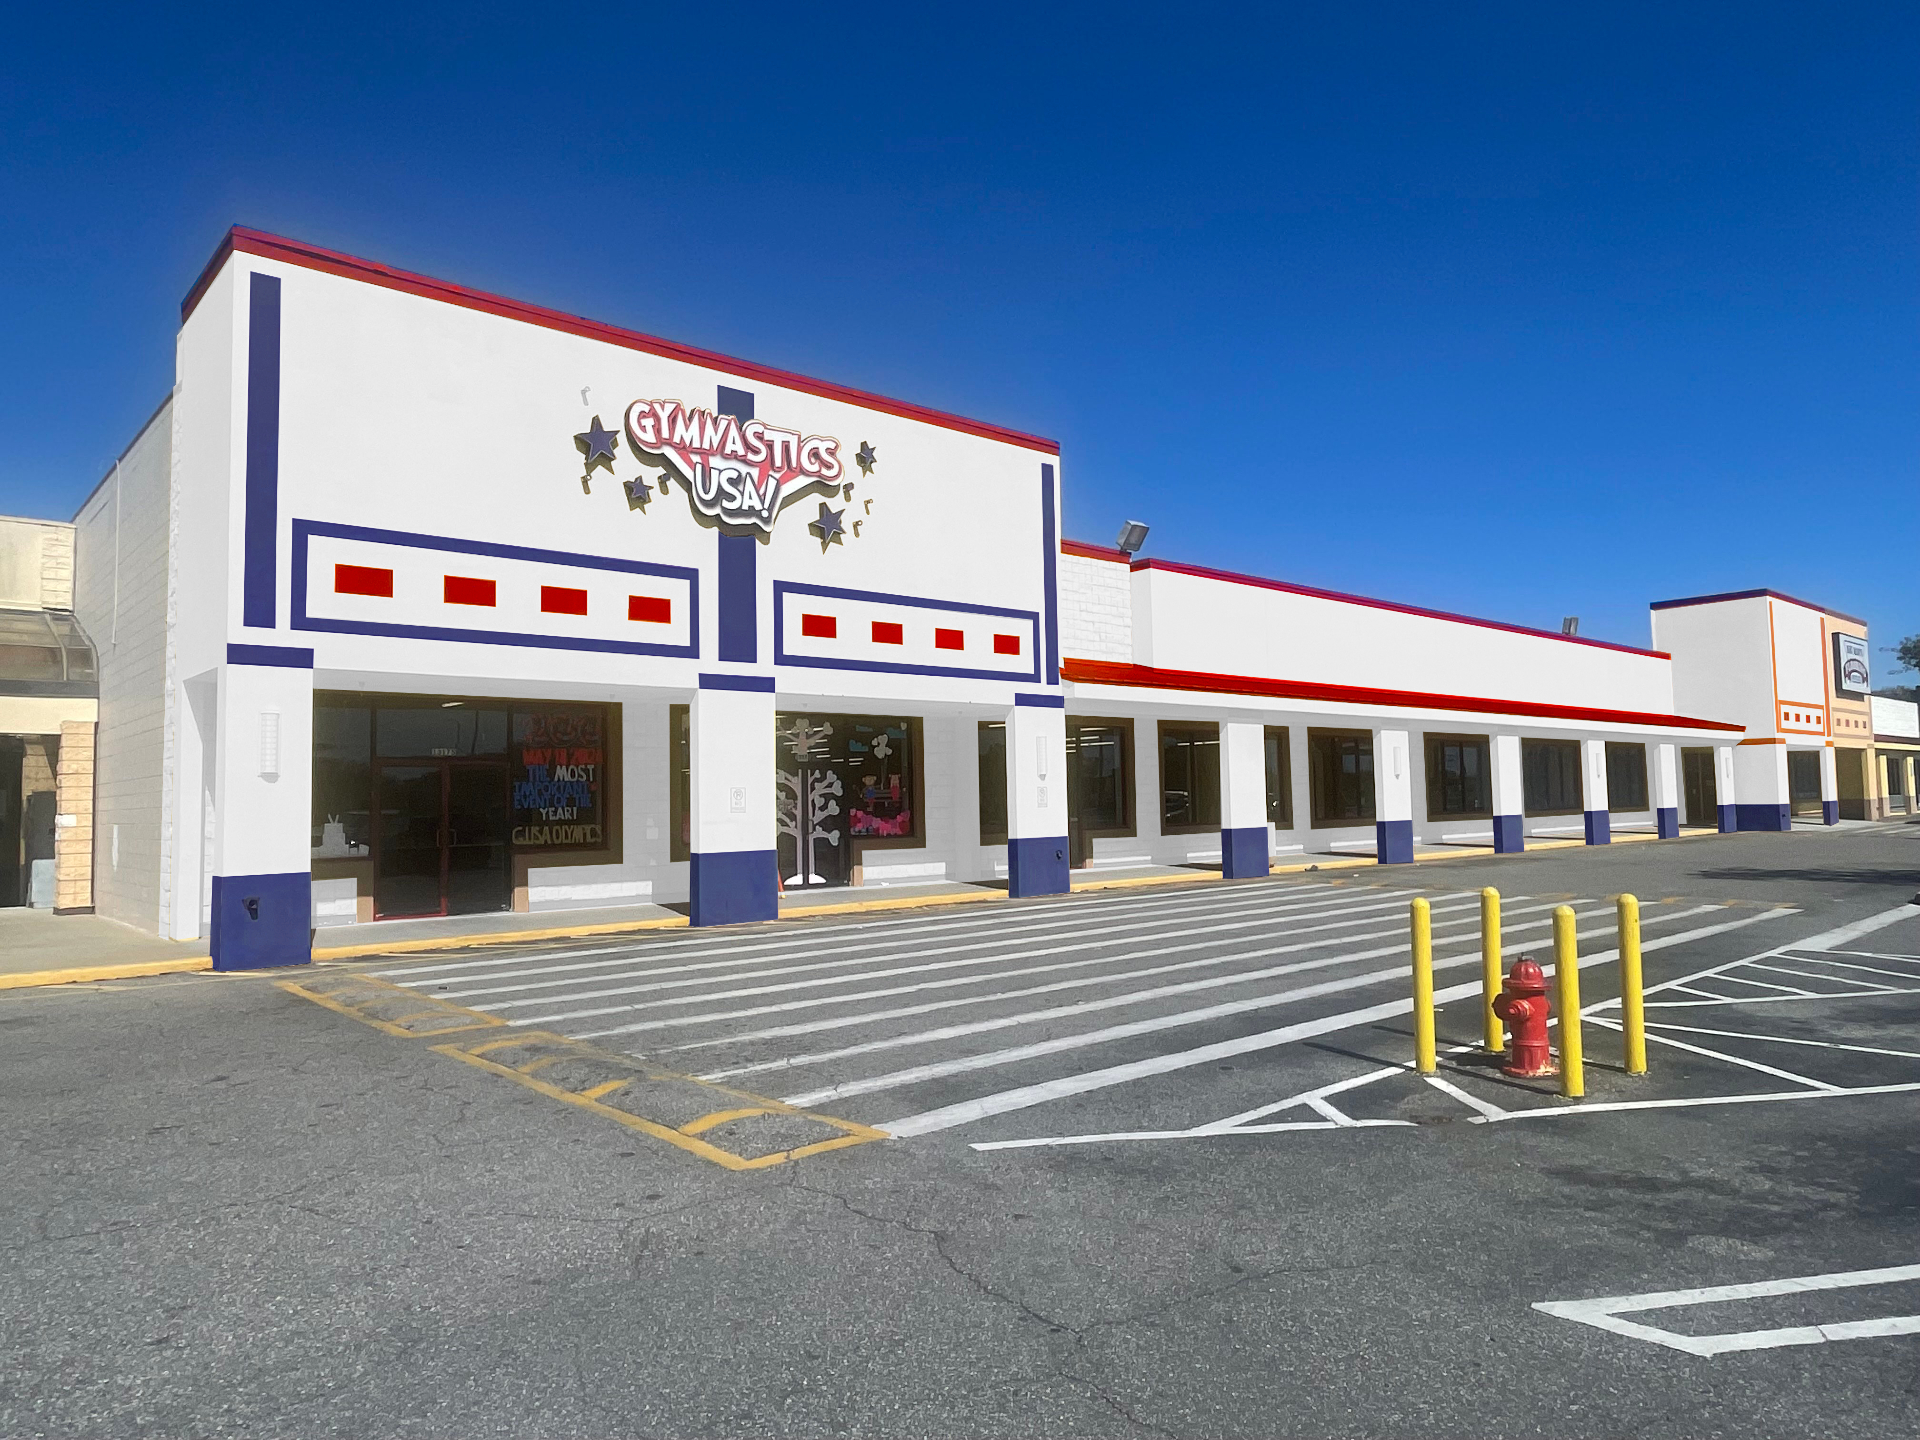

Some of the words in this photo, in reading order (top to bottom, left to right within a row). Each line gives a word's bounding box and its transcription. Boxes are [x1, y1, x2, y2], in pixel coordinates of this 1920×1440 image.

[628, 399, 842, 479] GYMNASTICS
[694, 462, 779, 519] USA!
[554, 764, 595, 782] MOST
[513, 781, 589, 796] IMPORTANT
[513, 794, 551, 809] EVENT
[540, 807, 578, 820] YEAR!
